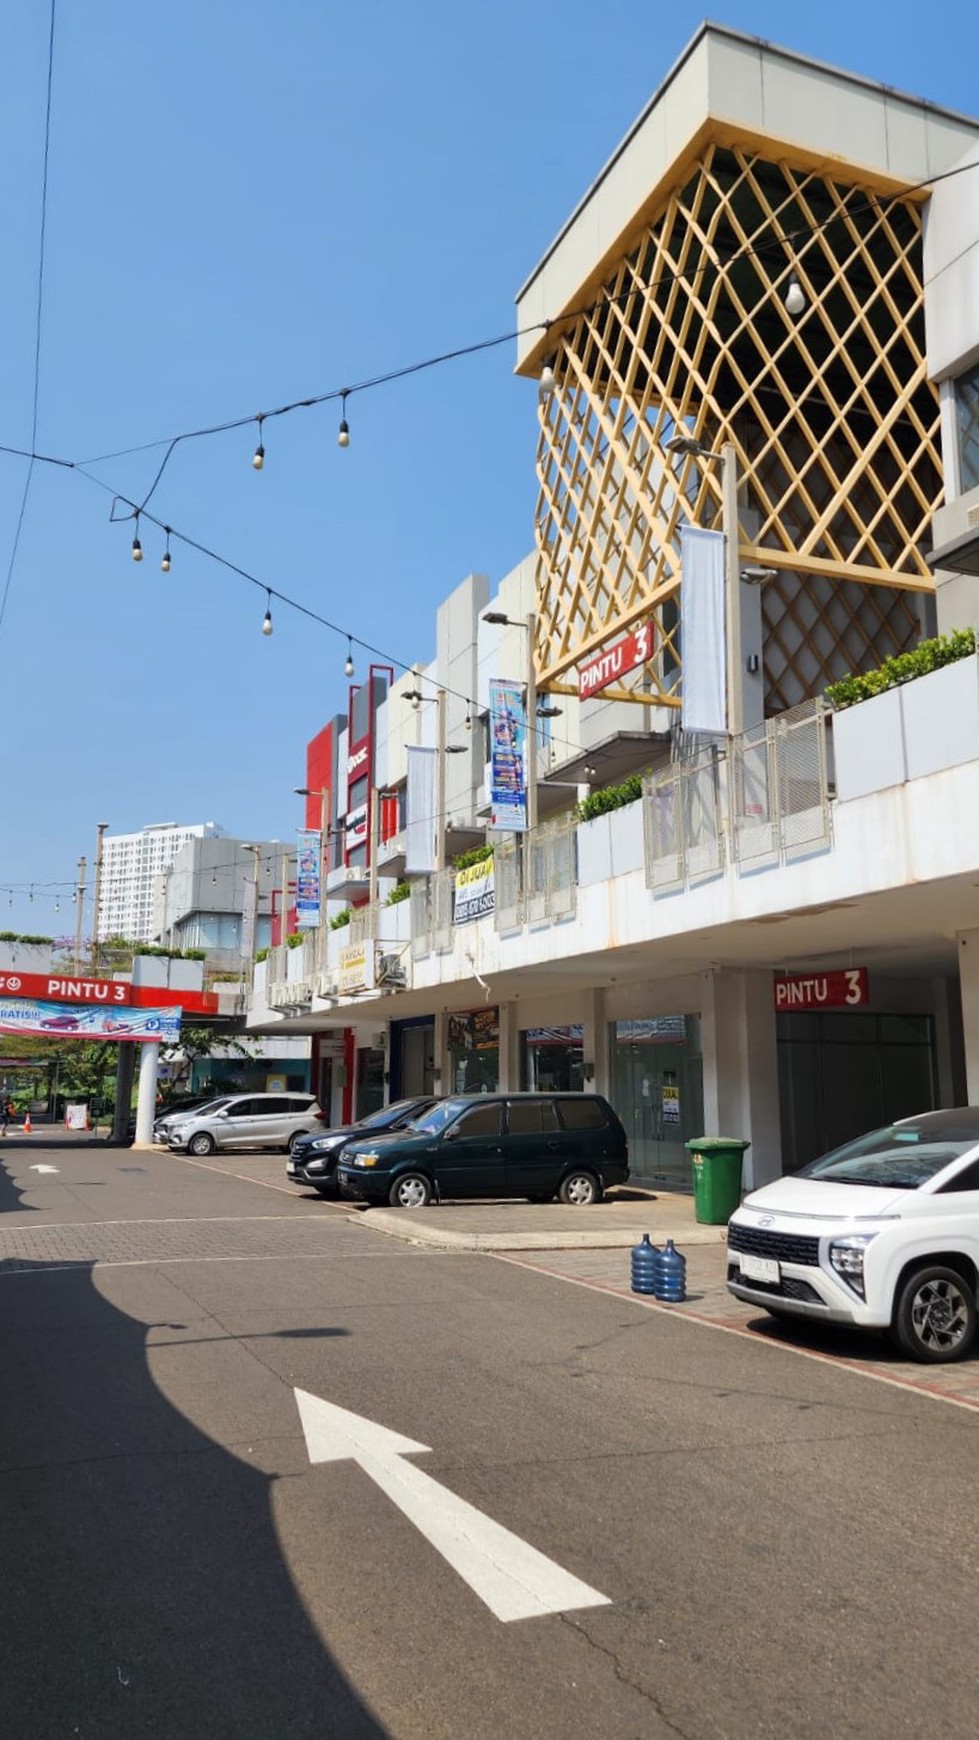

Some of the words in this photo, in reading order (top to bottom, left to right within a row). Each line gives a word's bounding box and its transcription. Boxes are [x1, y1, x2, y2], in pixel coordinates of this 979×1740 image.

[580, 646, 623, 693] PINTU
[633, 627, 648, 664] 3
[48, 980, 108, 999] PINTU
[114, 986, 125, 1001] 3
[776, 978, 828, 1005] PINTU
[844, 970, 861, 1005] 3
